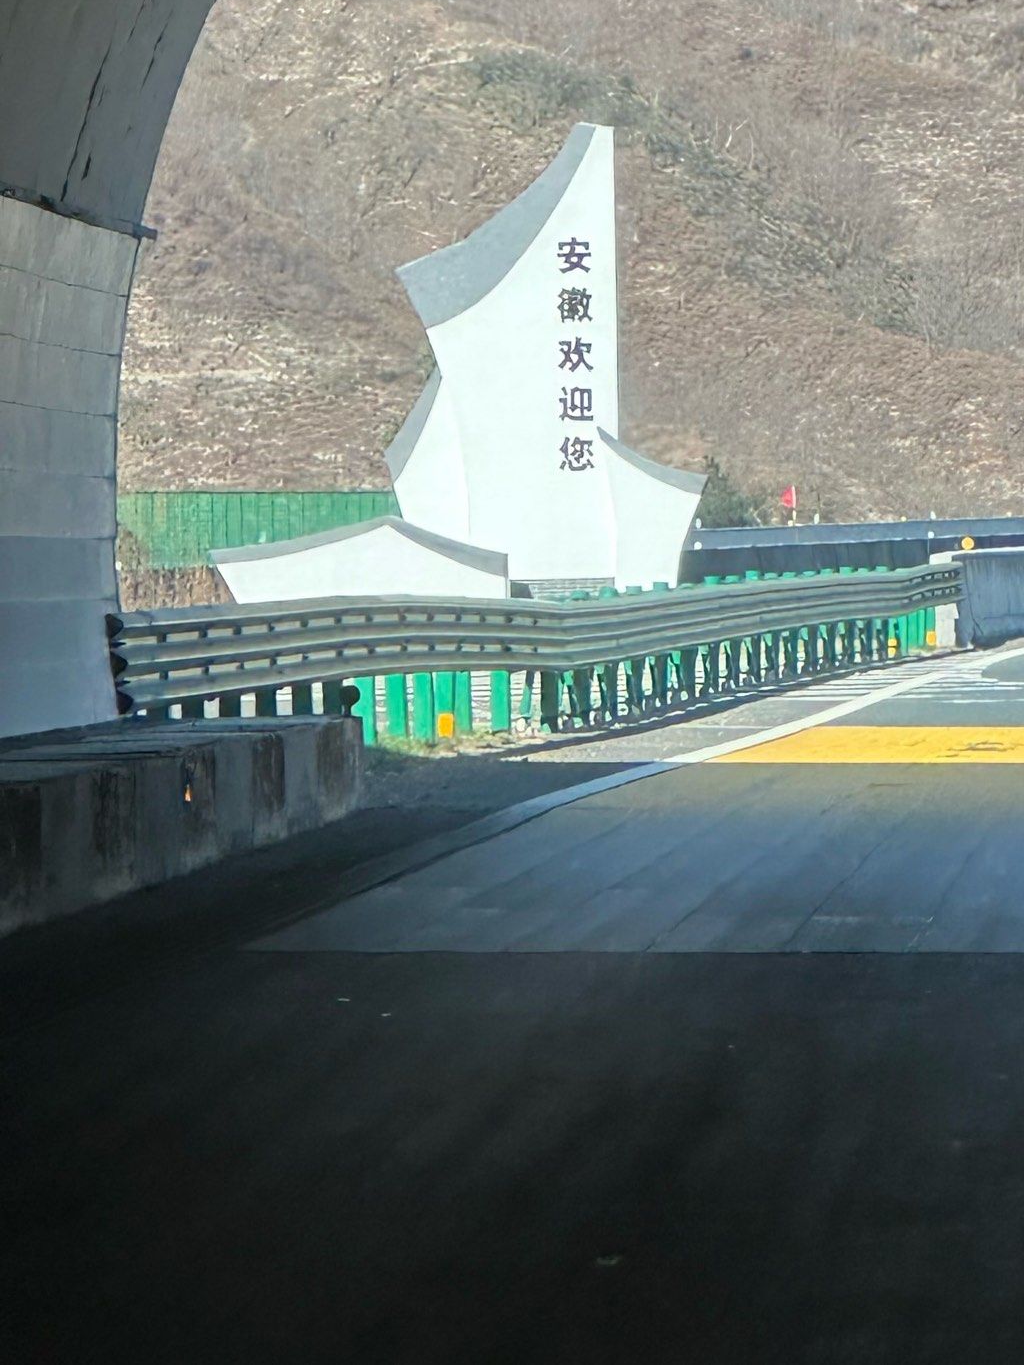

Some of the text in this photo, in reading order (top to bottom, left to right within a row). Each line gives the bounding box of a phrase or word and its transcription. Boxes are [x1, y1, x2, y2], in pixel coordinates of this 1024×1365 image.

[556, 237, 595, 472] 安徽欢迎您
